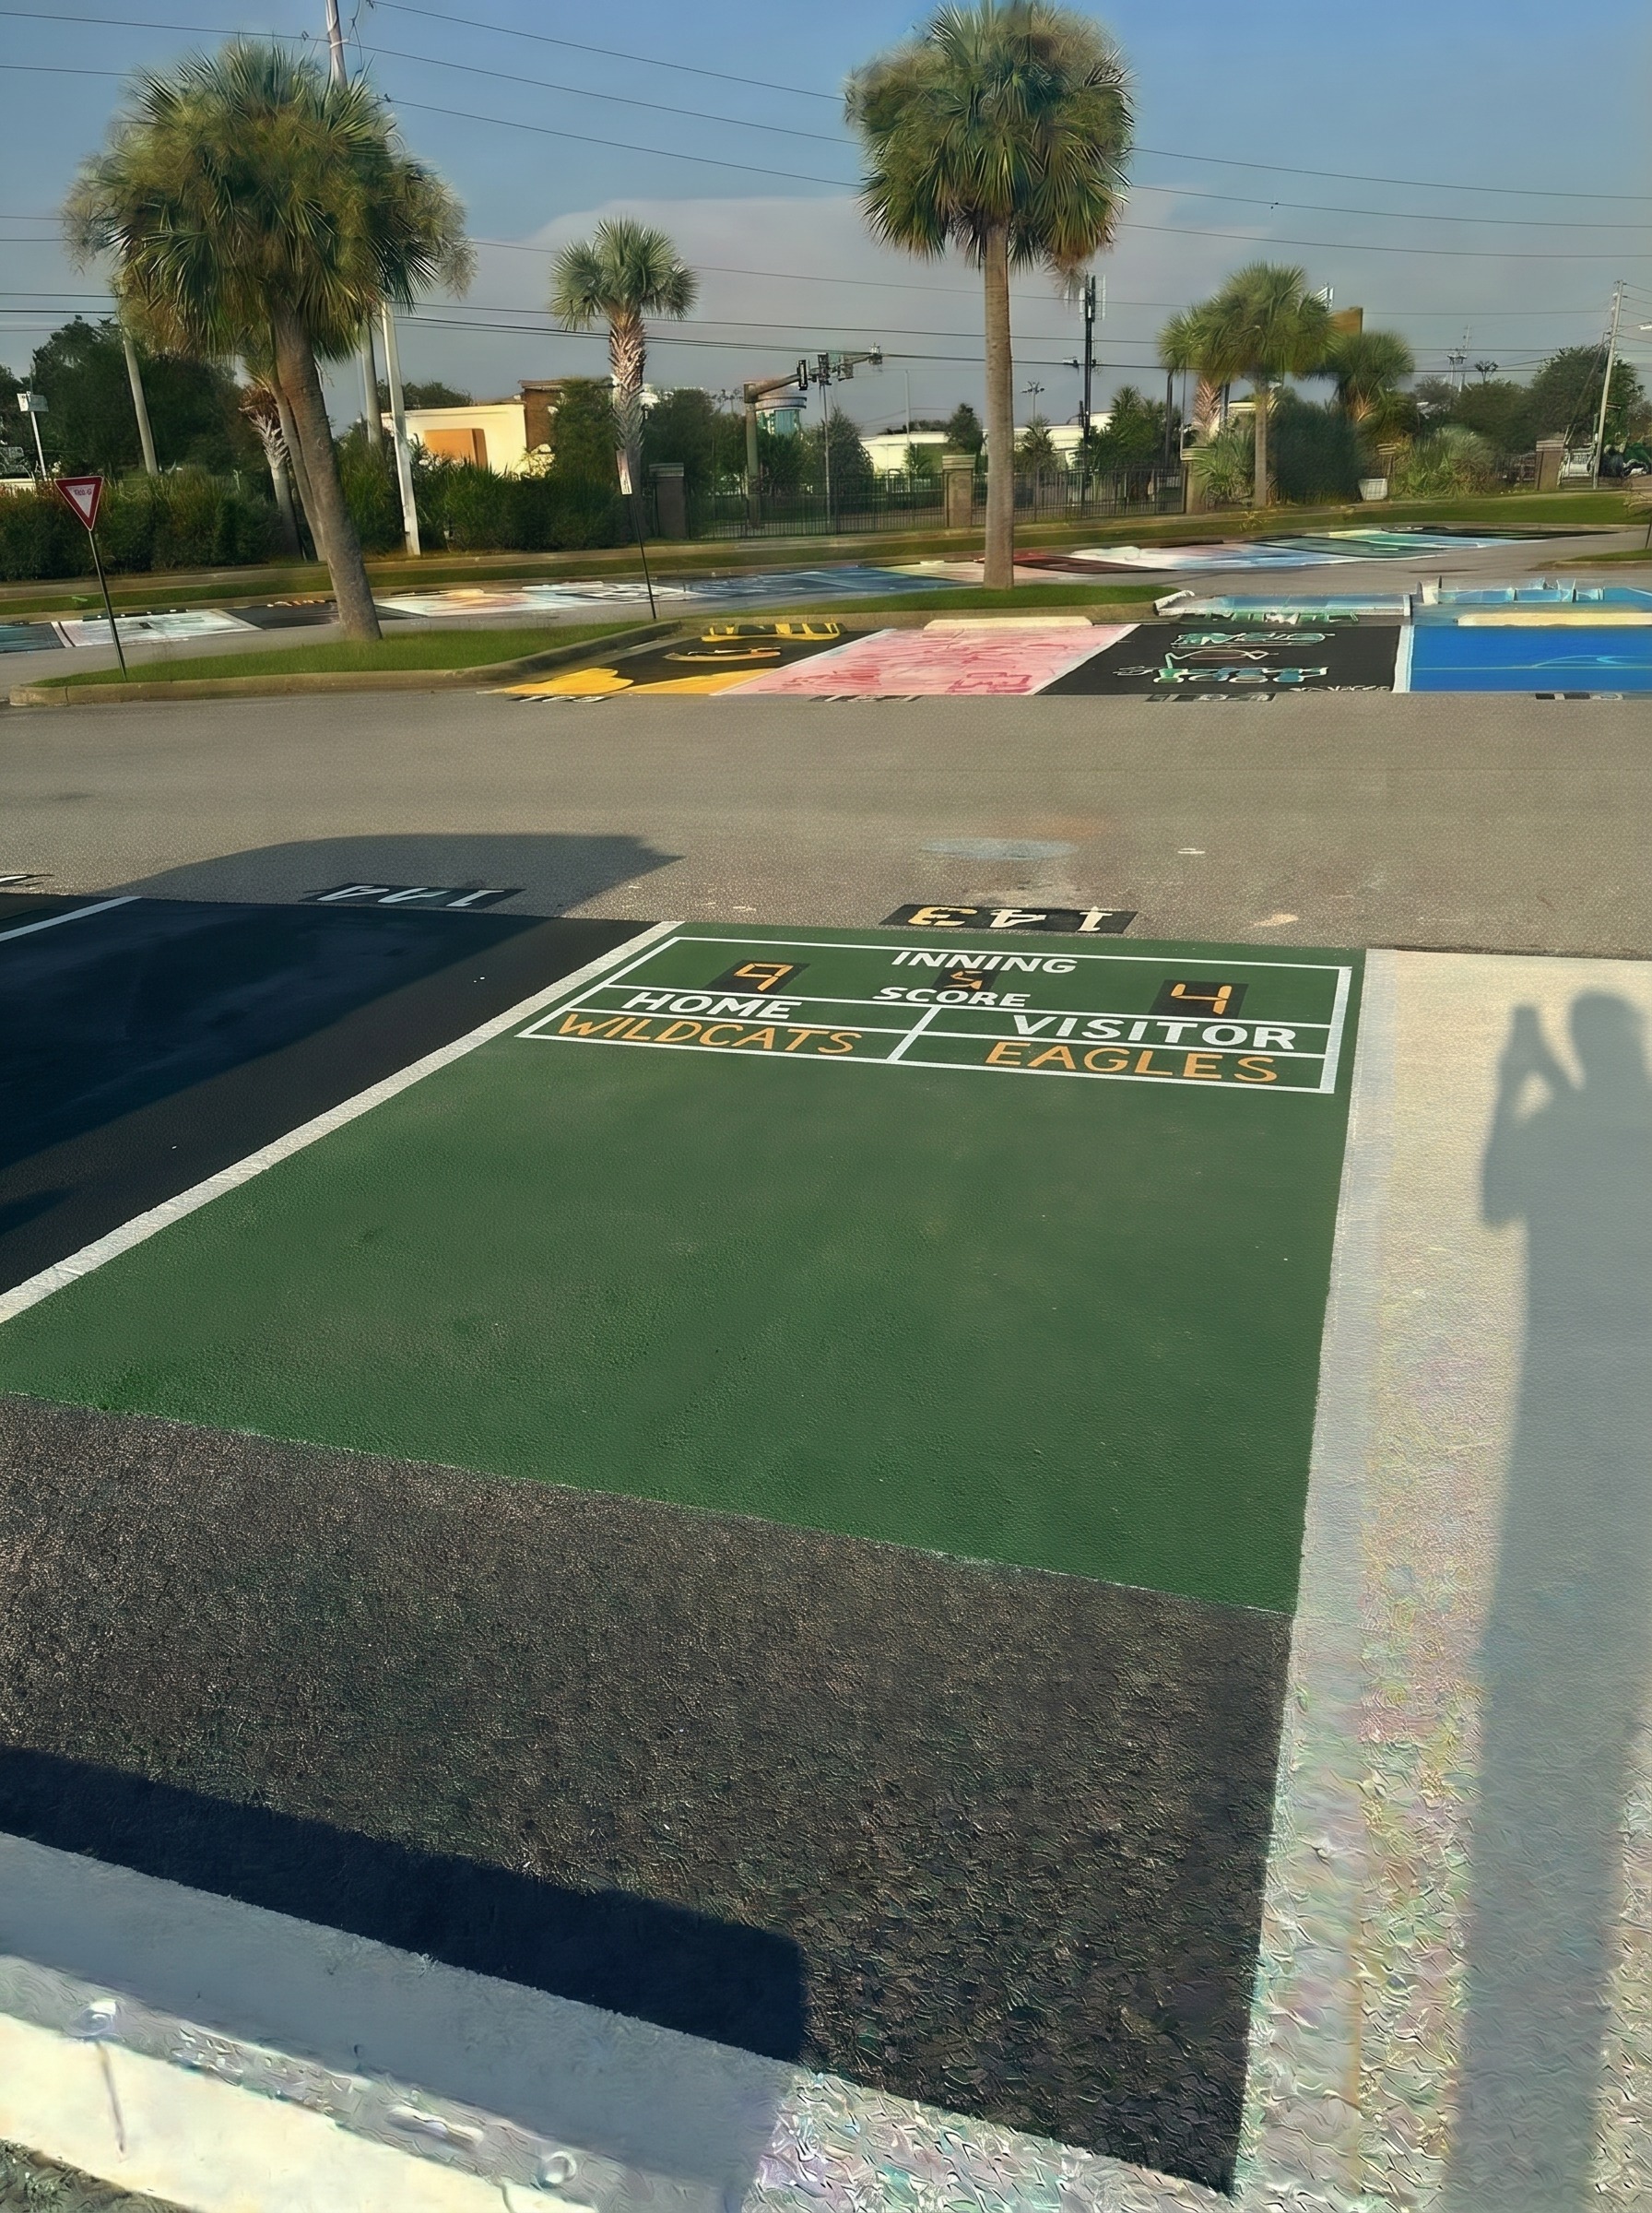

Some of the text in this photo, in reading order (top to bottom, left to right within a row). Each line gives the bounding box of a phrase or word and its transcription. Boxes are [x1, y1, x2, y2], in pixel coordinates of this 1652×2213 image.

[907, 906, 1113, 932] 143
[891, 951, 1078, 974] INNING
[734, 963, 794, 991] 9
[621, 991, 803, 1019] HOME
[872, 986, 1031, 1008] SCORE
[1171, 983, 1233, 1015] 4
[558, 1014, 862, 1054] WILDCATS
[1013, 1014, 1296, 1049] VISITOR
[985, 1041, 1278, 1083] EAGLES
